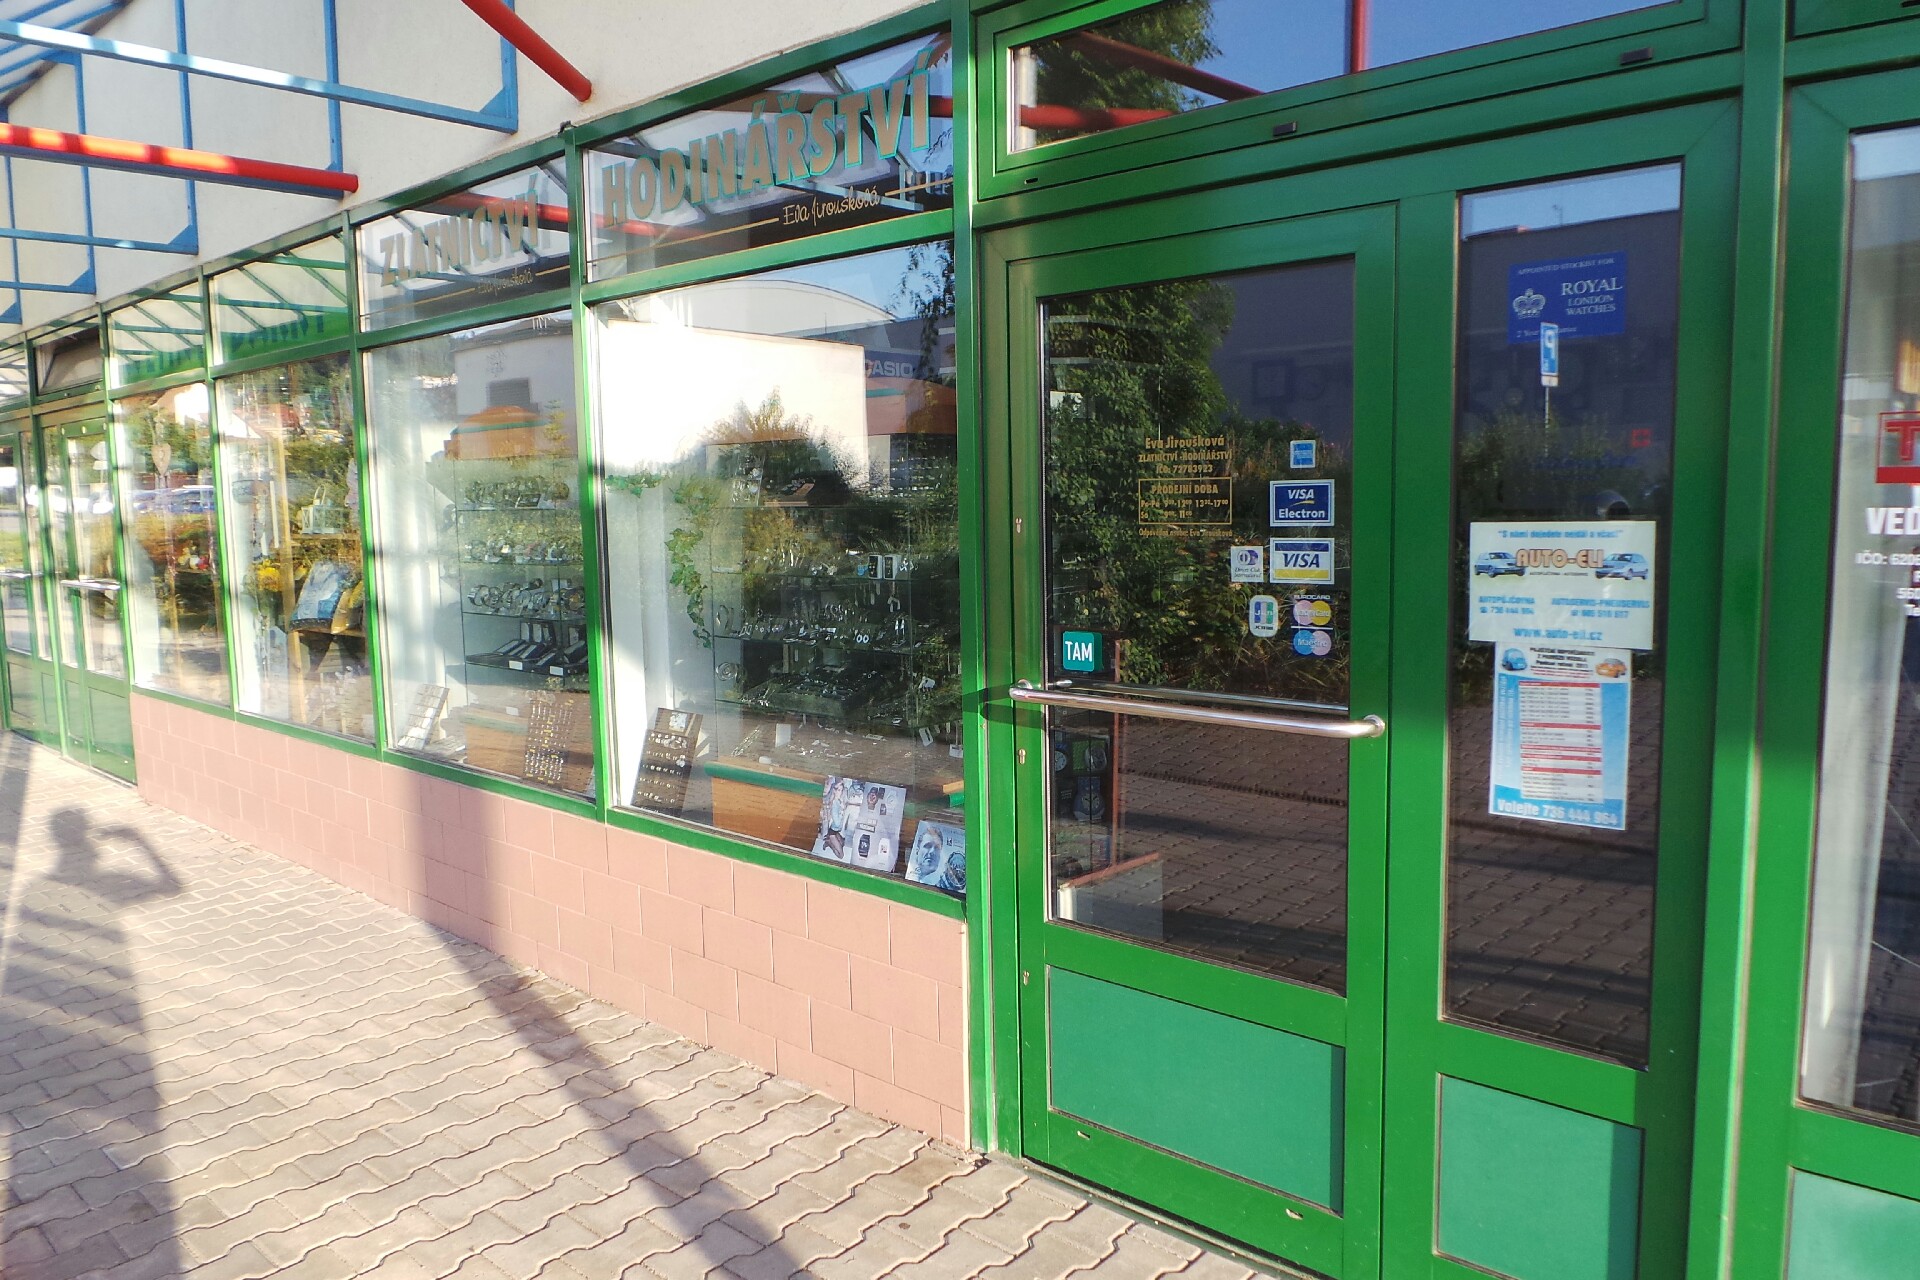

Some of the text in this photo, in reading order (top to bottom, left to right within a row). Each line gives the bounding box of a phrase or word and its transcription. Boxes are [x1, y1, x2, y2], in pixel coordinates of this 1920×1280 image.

[602, 45, 934, 228] HODINÁŘSTVÍ
[783, 204, 811, 226] Eva
[380, 172, 540, 288] ZLATNICTVÍ
[1561, 277, 1623, 296] ROYAL
[1568, 294, 1614, 307] LONDON
[1566, 303, 1616, 316] WATCHES
[1145, 434, 1225, 449] Eva Jiroušková
[1151, 482, 1219, 494] PRODEJNÍ DOBA
[1288, 488, 1315, 500] VISA
[1278, 508, 1326, 520] Electron
[1282, 552, 1321, 569] VISA
[1515, 549, 1604, 568] AUTO-ELI
[1856, 549, 1888, 565] IČO:
[1297, 638, 1328, 648] Maestro
[1065, 641, 1093, 662] TAM
[1498, 799, 1540, 816] Volejte
